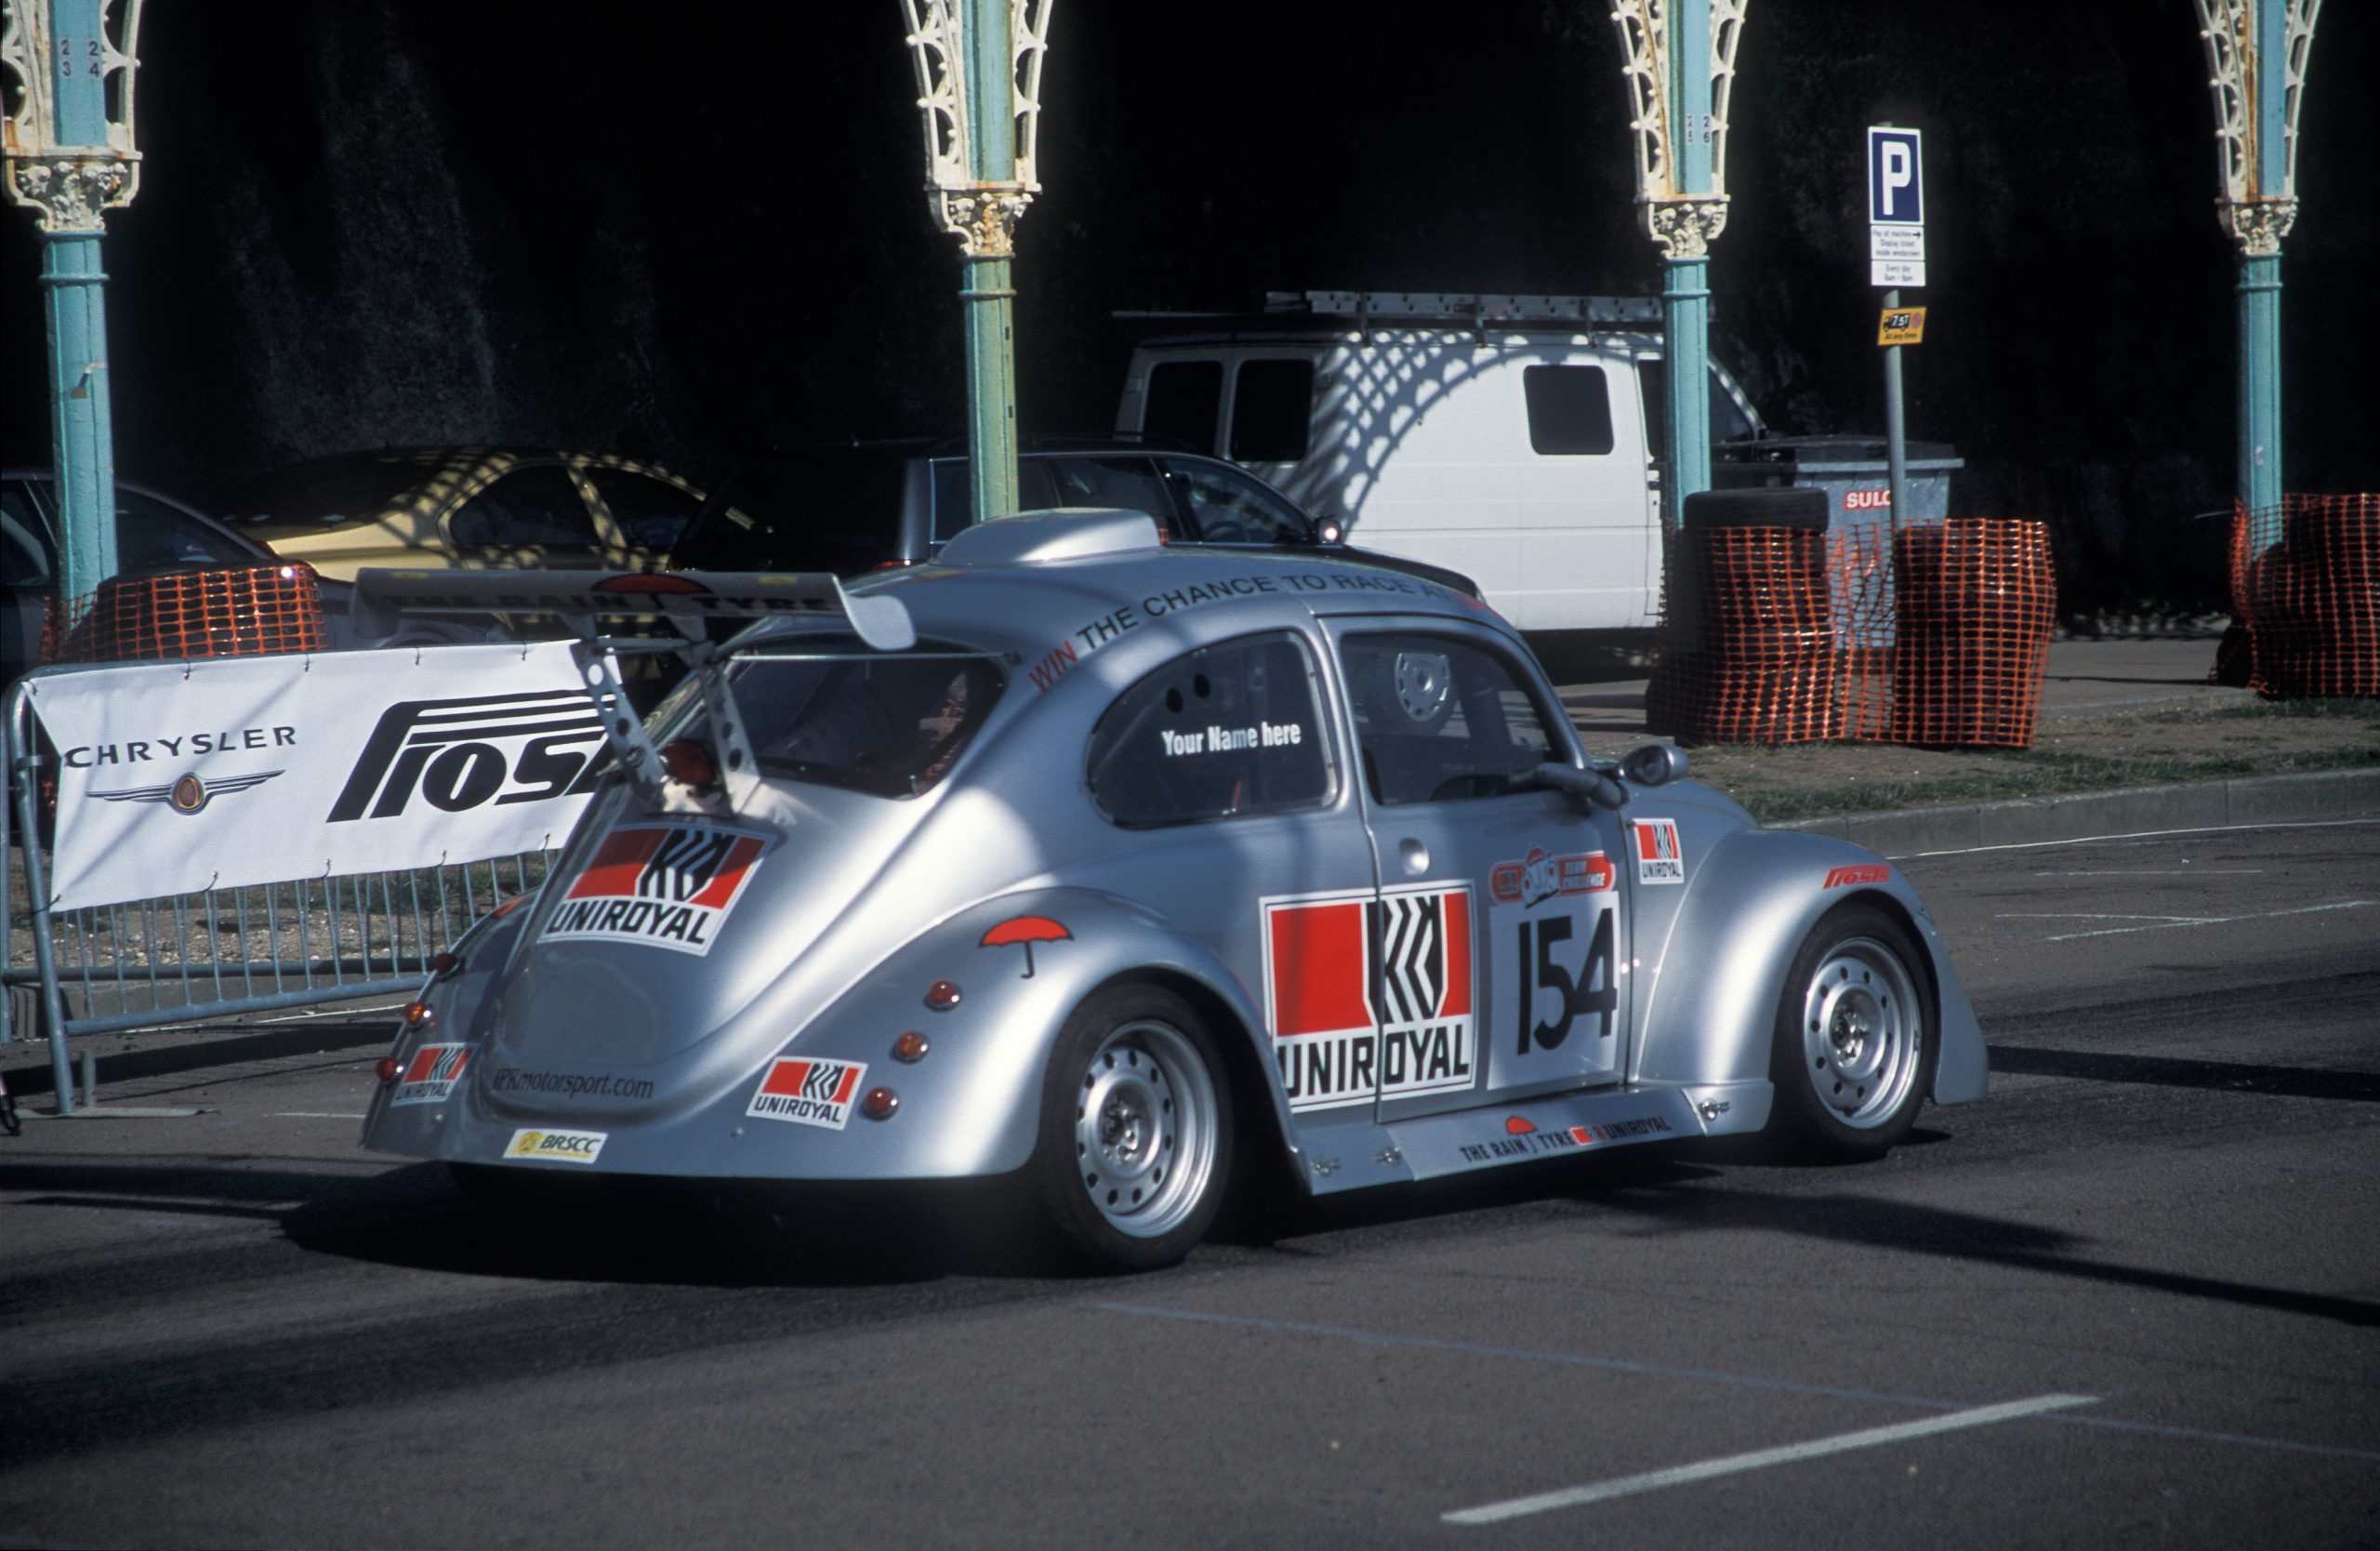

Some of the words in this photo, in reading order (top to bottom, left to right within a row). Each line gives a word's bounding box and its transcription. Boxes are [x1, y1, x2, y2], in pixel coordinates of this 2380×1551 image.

[1882, 140, 1911, 216] P
[1029, 640, 1078, 693] WIN
[1076, 606, 1140, 650] THE
[1143, 576, 1279, 617] CHANCE
[1280, 574, 1328, 591] TO
[1330, 574, 1416, 595] RACE
[64, 726, 297, 768] CHRYSLER
[1161, 730, 1204, 756] Your
[1208, 725, 1259, 751] Name
[1261, 721, 1302, 747] here
[1642, 862, 1682, 878] UNIROYAL
[547, 898, 709, 945] UNIROYAL
[1517, 908, 1618, 1055] 154
[1278, 1024, 1469, 1096] UNIROYAL
[754, 1095, 841, 1122] UNIROYAL
[540, 1134, 602, 1153] BRSCC
[1460, 1145, 1491, 1163] THE
[1491, 1138, 1527, 1157] RAIN
[1538, 1130, 1575, 1150] TYRE
[1605, 1116, 1673, 1140] UNIROYAL
